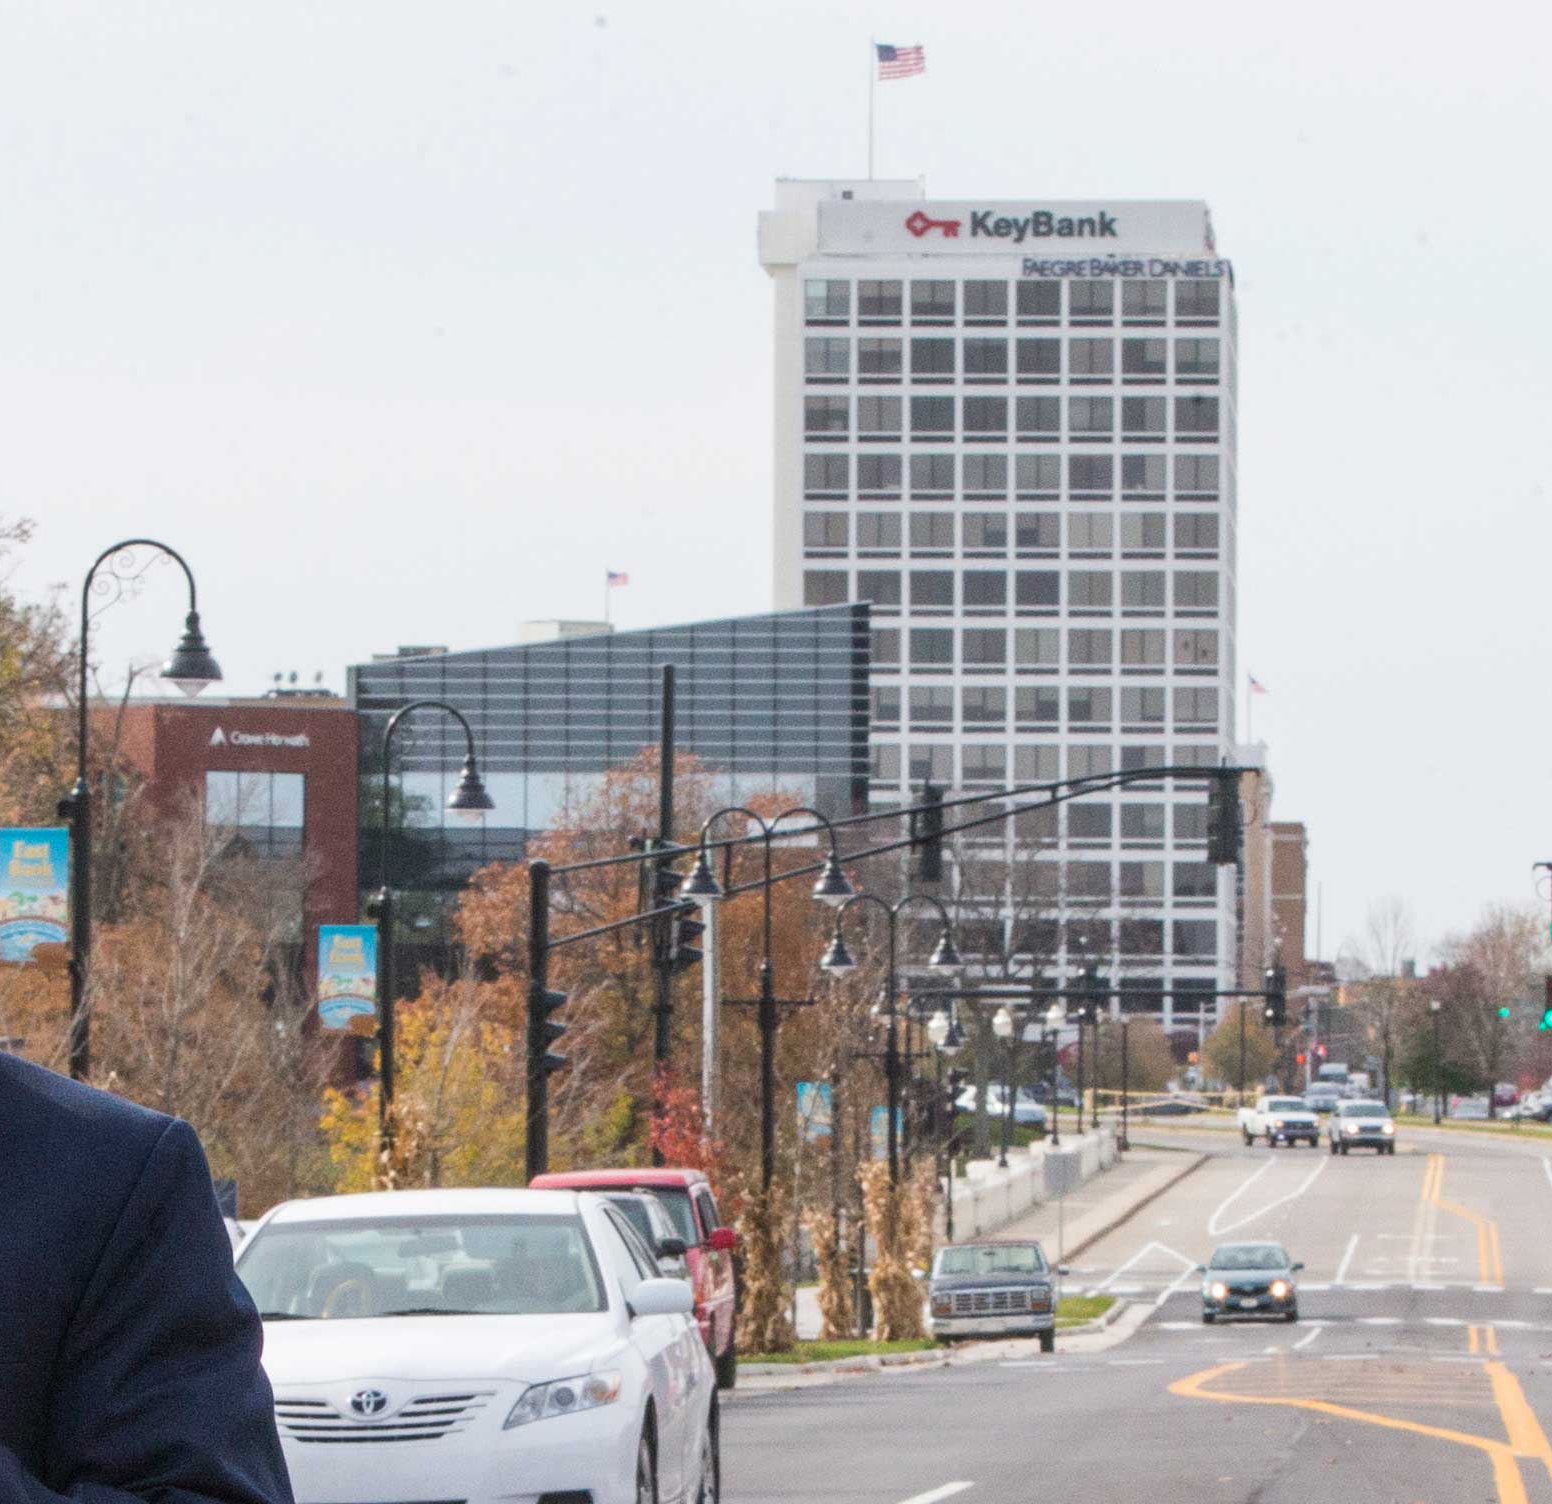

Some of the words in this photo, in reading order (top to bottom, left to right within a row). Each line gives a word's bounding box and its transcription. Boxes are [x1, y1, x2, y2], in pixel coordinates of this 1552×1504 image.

[969, 209, 1119, 244] KeyBank
[1090, 258, 1146, 277] BAKER
[1150, 258, 1224, 278] DANIELS
